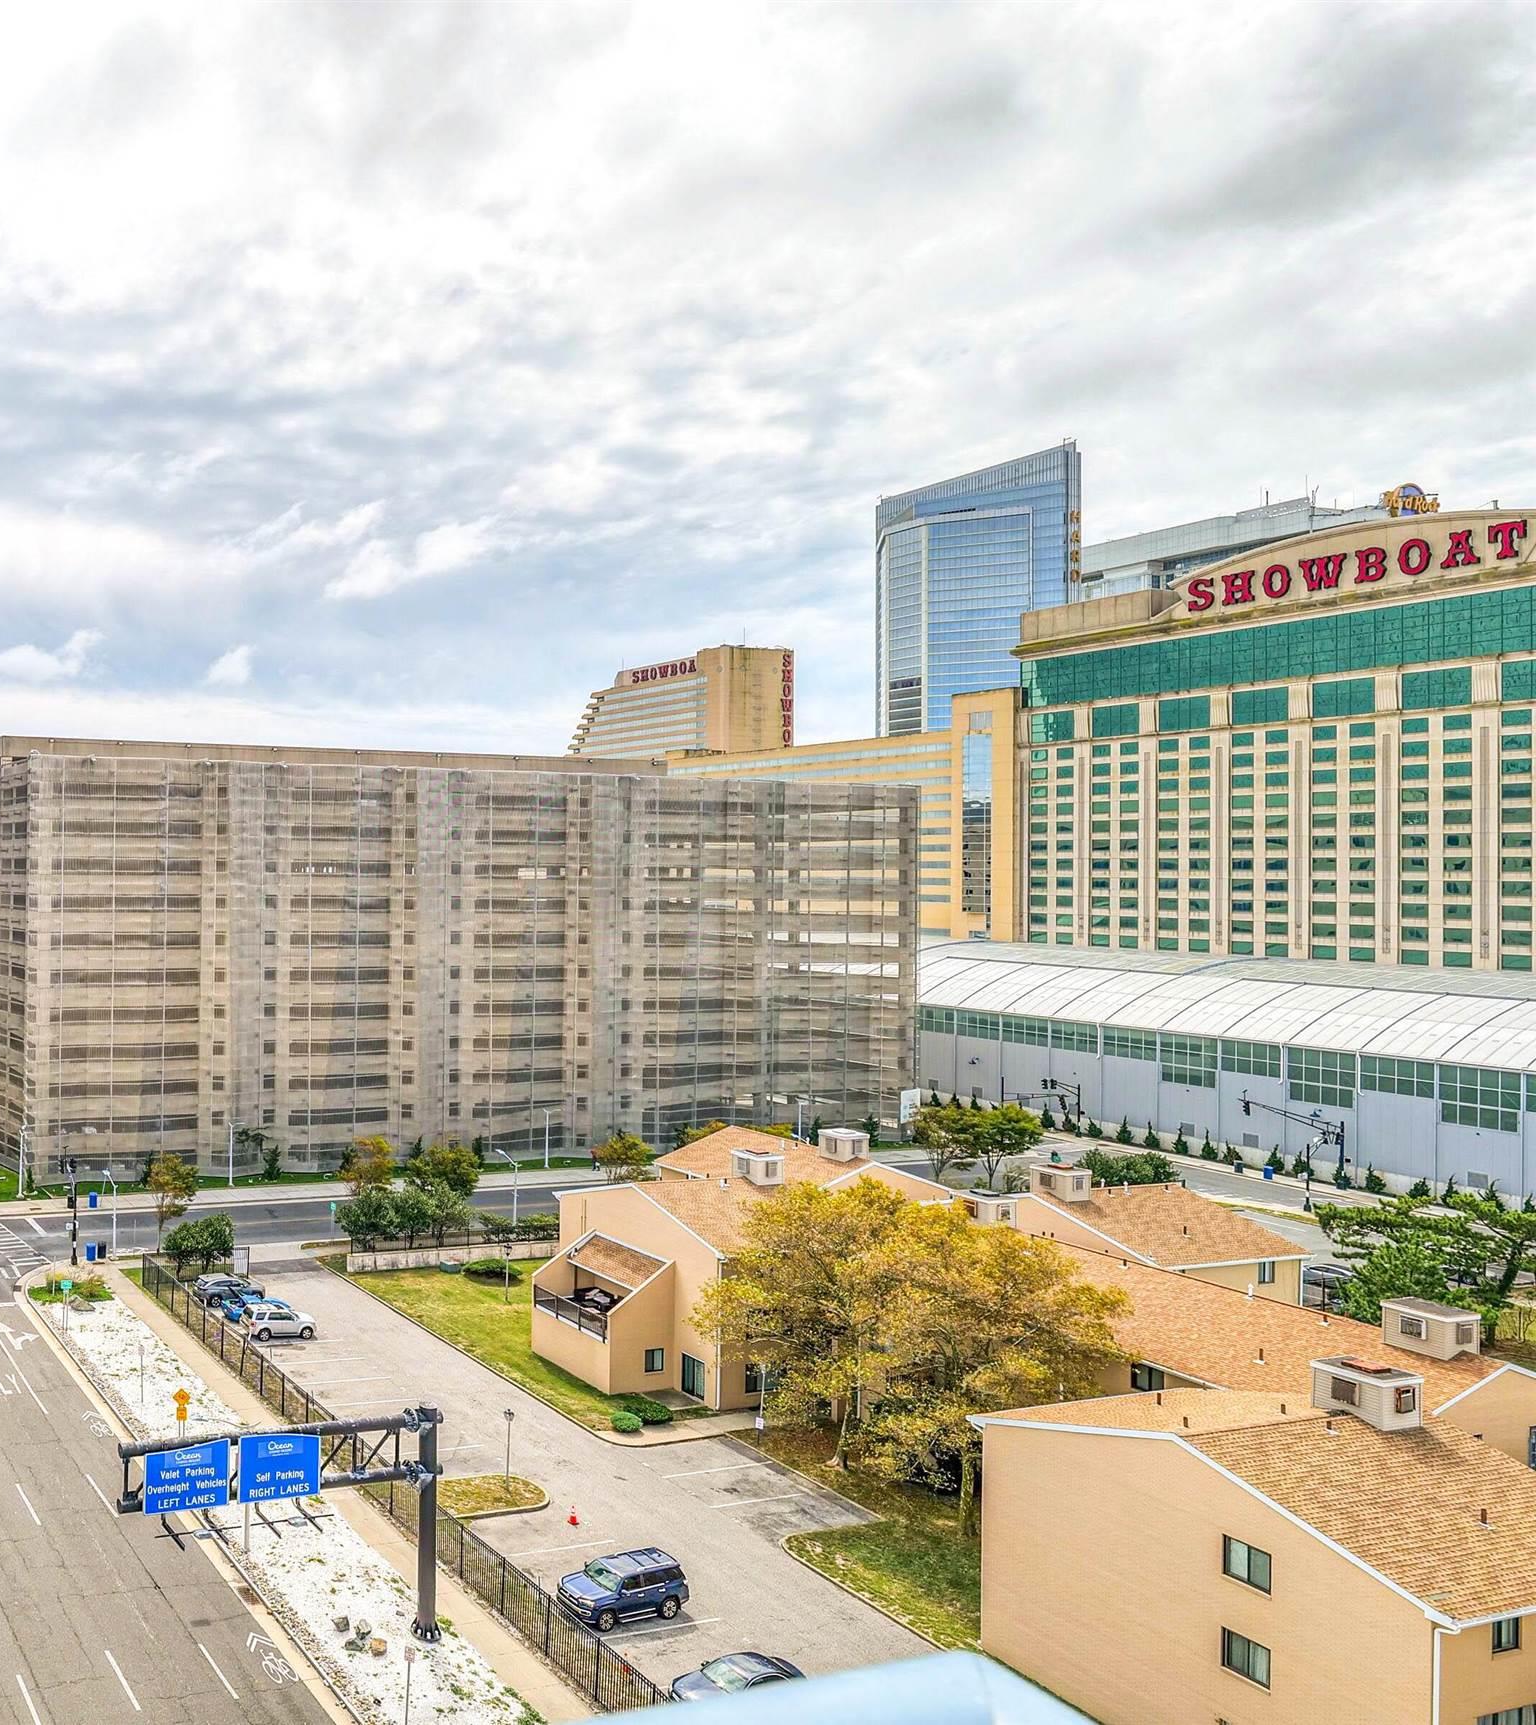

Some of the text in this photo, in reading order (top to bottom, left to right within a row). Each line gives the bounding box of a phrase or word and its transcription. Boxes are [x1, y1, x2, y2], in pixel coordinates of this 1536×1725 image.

[1187, 519, 1528, 612] SHOWBOAT
[632, 659, 697, 684] SHOWBOA
[780, 654, 793, 746] SHOWBO
[267, 1441, 294, 1450] Ocean
[175, 1451, 202, 1460] Ocean
[160, 1467, 215, 1480] Valet Parking
[256, 1469, 304, 1482] Self Parking
[147, 1478, 226, 1495] Overheight Vehicles
[249, 1483, 310, 1498] RIGHT LANES
[158, 1494, 215, 1509] LEFT LANES
